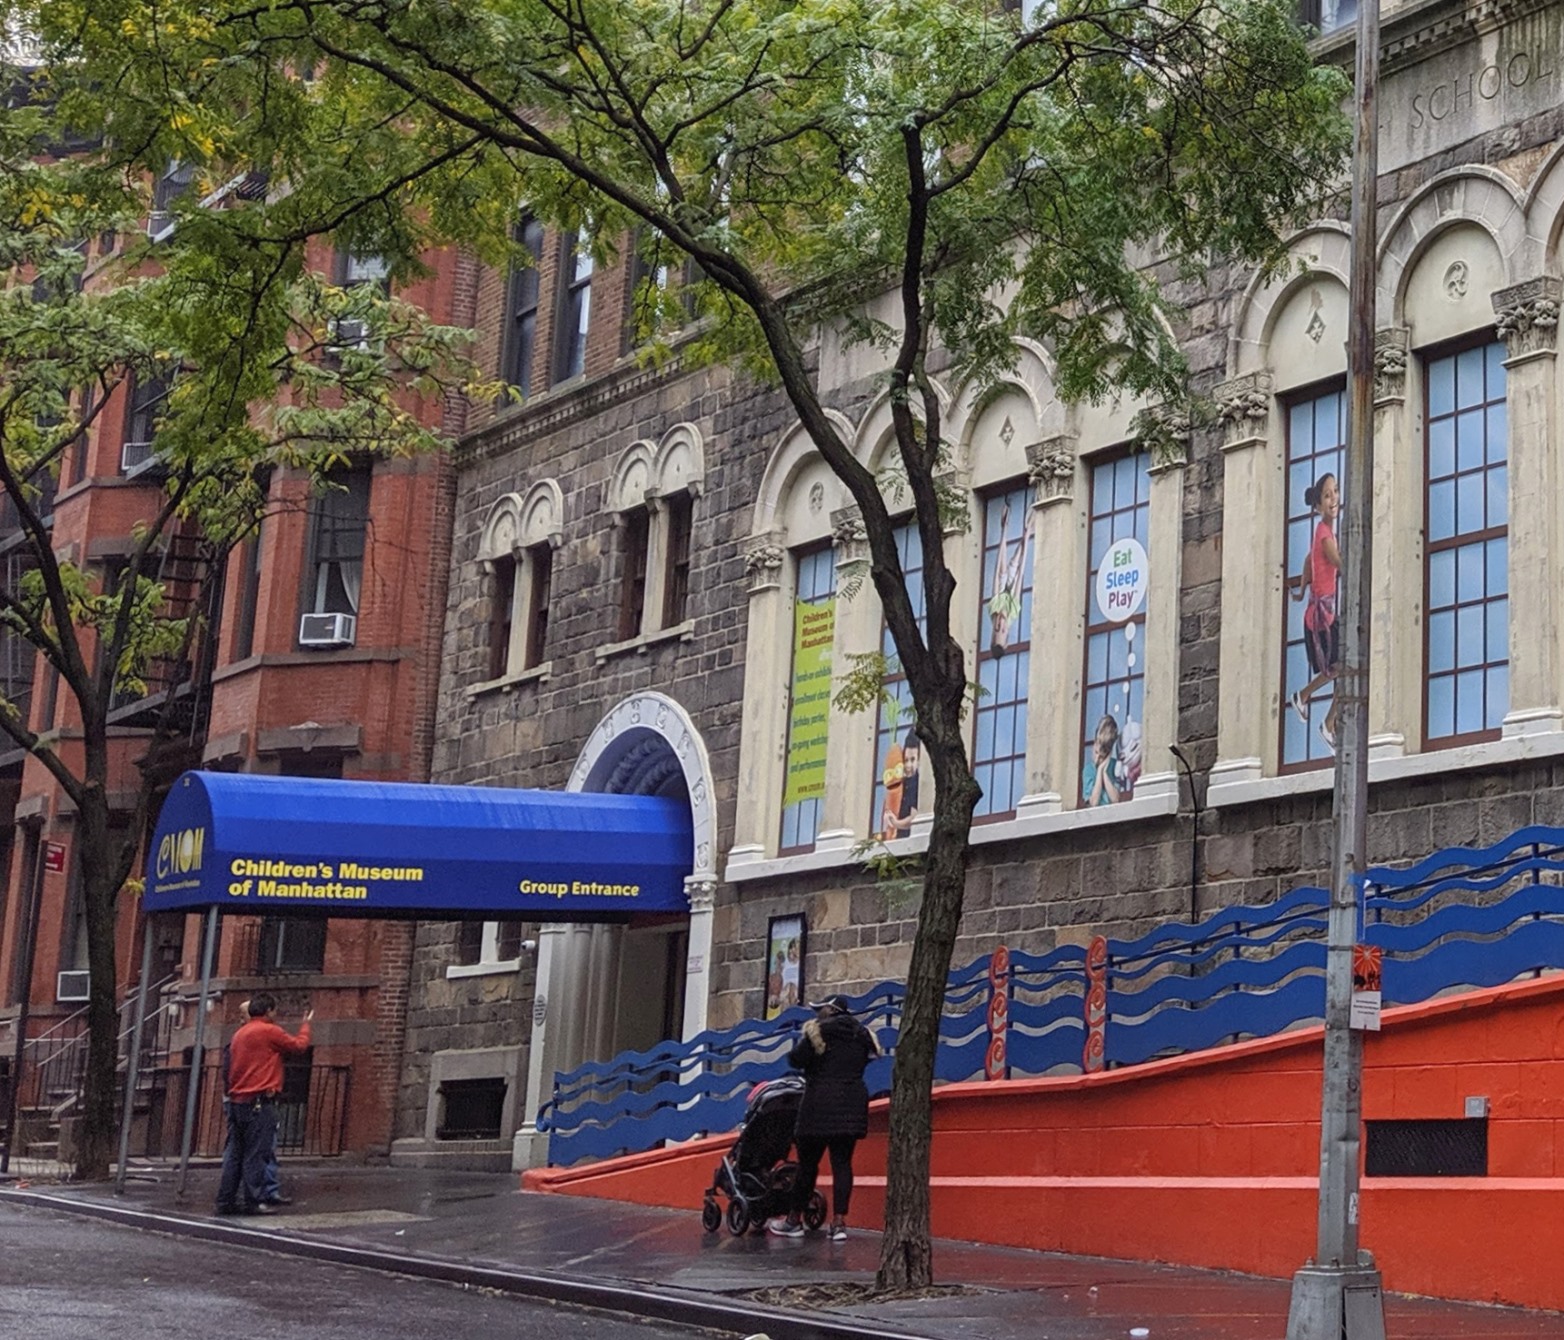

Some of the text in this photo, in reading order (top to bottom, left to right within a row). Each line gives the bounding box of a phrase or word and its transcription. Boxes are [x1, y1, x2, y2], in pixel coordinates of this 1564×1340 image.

[1411, 47, 1553, 129] SCHOOL
[1113, 548, 1132, 568] Eat
[1106, 569, 1139, 590] Sleep
[1108, 590, 1134, 609] Play
[231, 858, 423, 881] Children's Museum
[228, 880, 367, 899] of Manhattan
[520, 880, 640, 898] Group Entrance
